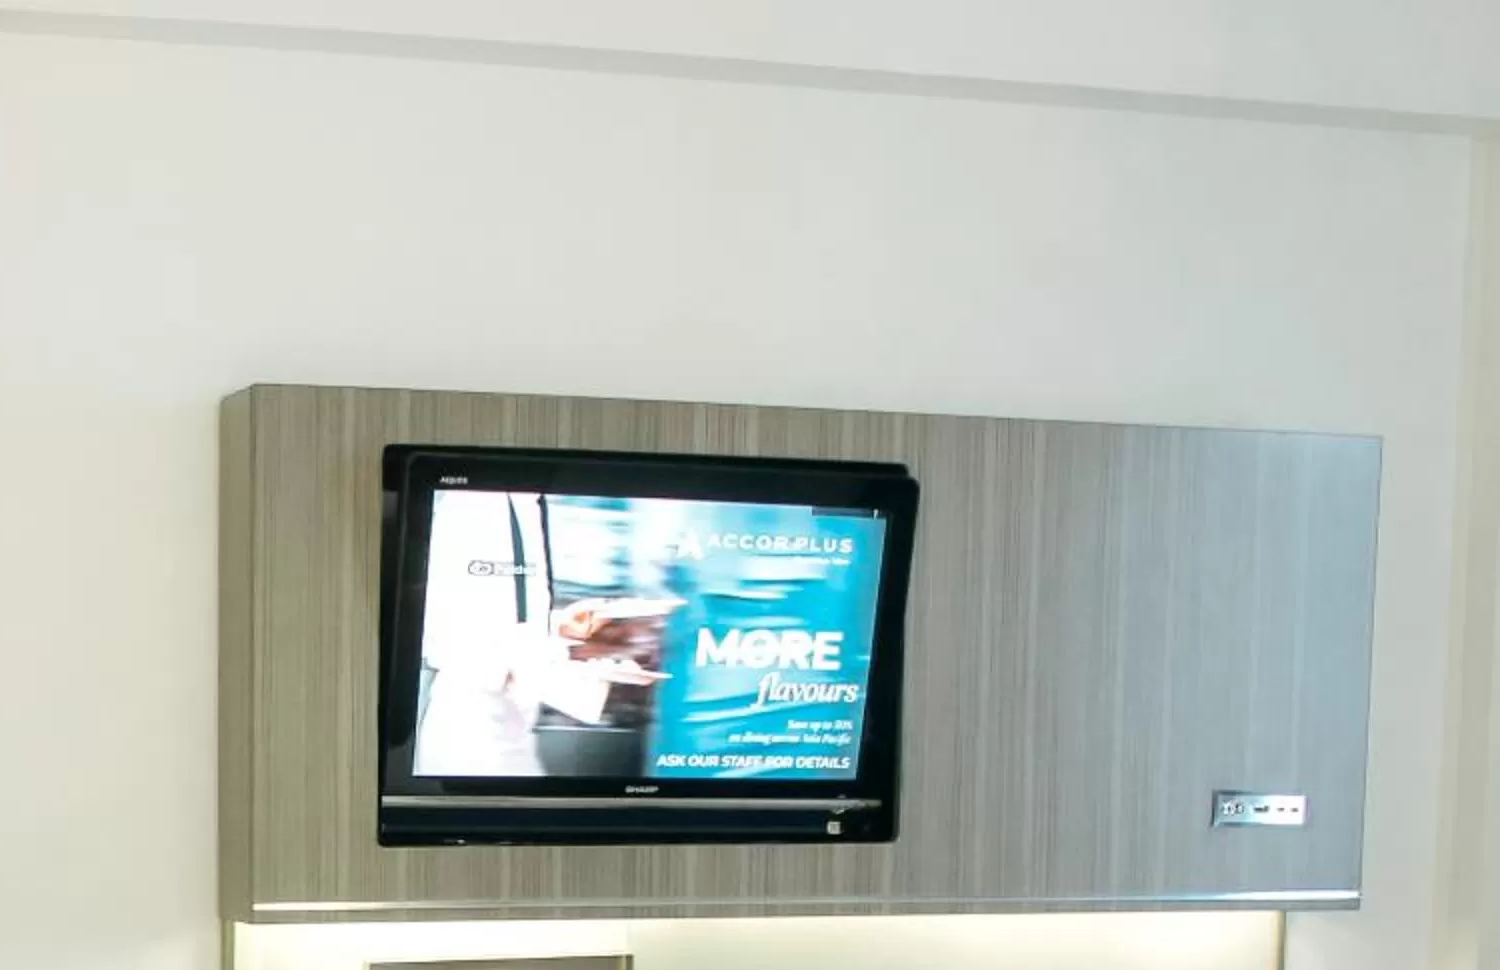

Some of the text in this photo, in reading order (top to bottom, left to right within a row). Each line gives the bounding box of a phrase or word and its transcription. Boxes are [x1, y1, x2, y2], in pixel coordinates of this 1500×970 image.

[707, 532, 853, 553] ACCOR PLUS
[696, 627, 844, 671] MORE
[753, 671, 859, 709] flavours
[656, 754, 685, 768] ASK
[687, 754, 719, 768] OUR
[795, 756, 851, 769] DETAILS
